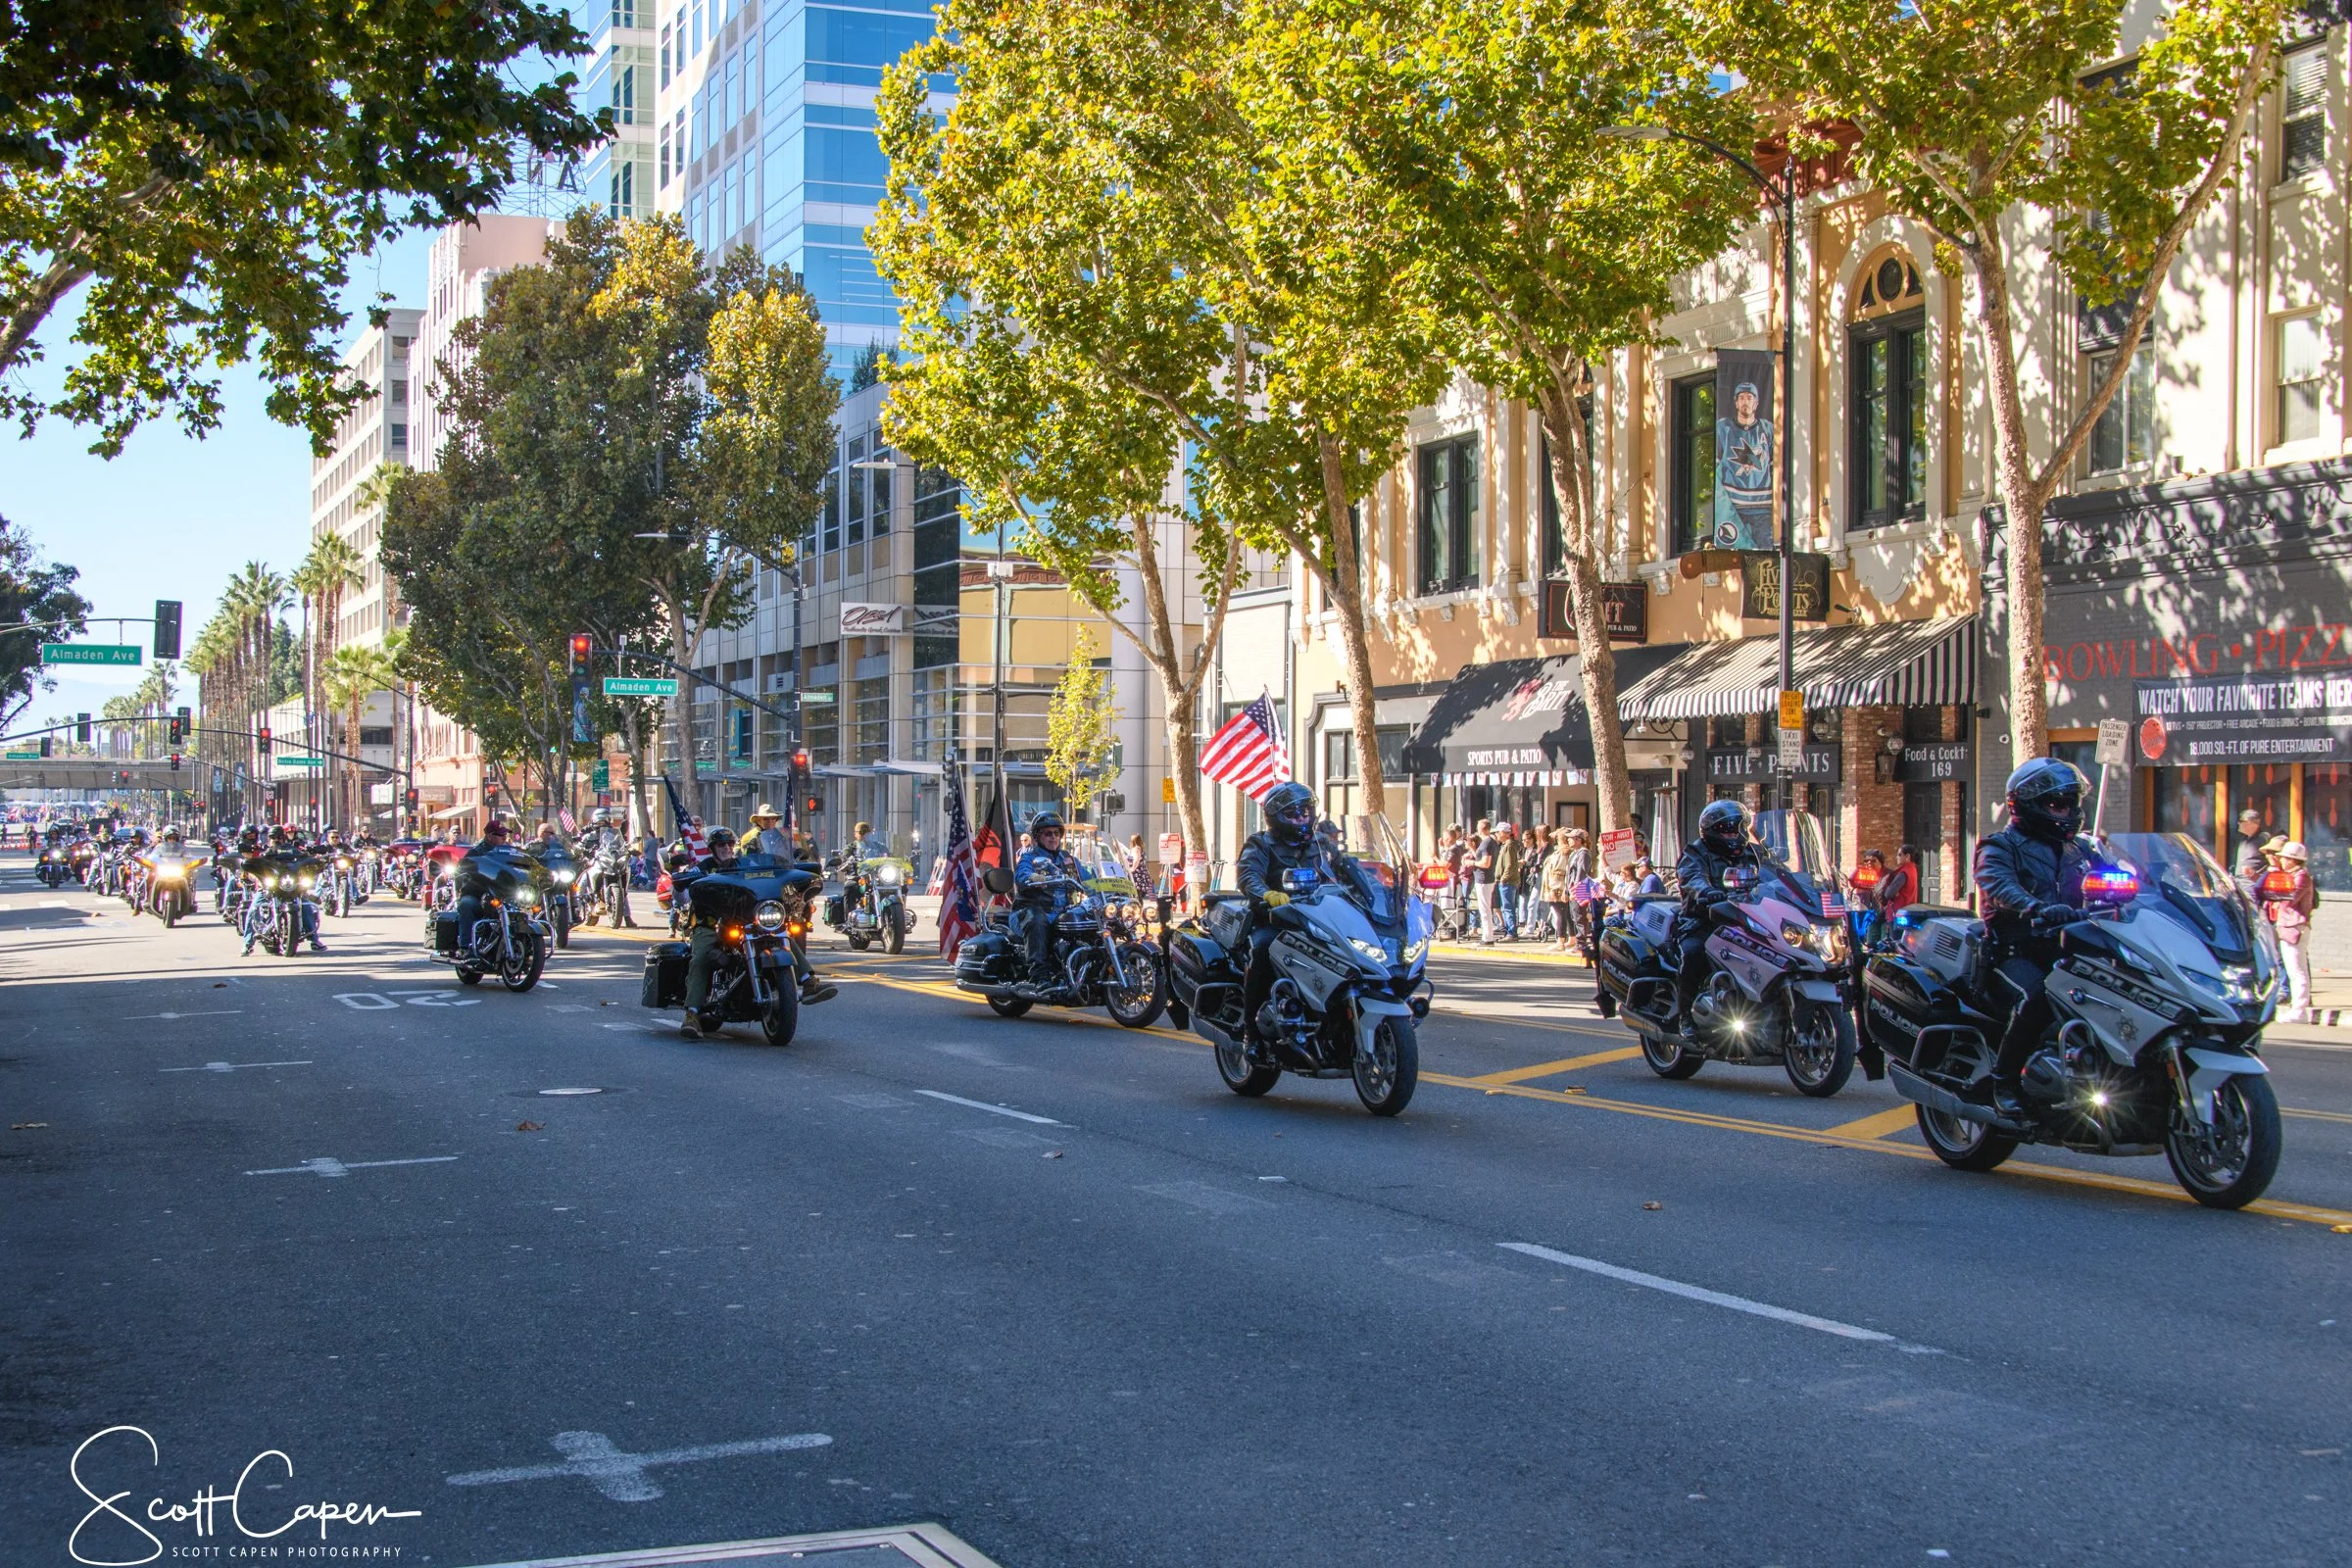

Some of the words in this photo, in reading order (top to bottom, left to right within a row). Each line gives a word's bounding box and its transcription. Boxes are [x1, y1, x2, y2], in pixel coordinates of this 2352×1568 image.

[1757, 558, 1781, 586] FIV
[1759, 585, 1811, 613] POTS
[51, 649, 104, 661] Almaden
[113, 651, 135, 661] Ave
[2042, 633, 2218, 682] BOWLING
[2255, 622, 2352, 669] PIZZ
[610, 682, 650, 691] Almaden
[656, 683, 673, 692] Ave
[1551, 680, 1570, 691] THE
[1519, 682, 1572, 720] BRIT
[2138, 688, 2180, 714] WATCH
[2182, 686, 2214, 713] YOUR
[2217, 683, 2276, 712] FAVORITE
[2278, 680, 2325, 709] TEAMS
[2101, 721, 2127, 731] PASSENGER
[2196, 719, 2224, 730] PROJECTOR
[2227, 718, 2238, 729] FREE
[2239, 718, 2259, 728] ARCADE
[2101, 730, 2125, 739] LOADING
[1904, 747, 1927, 761] Food
[1930, 750, 1936, 760] &
[2188, 740, 2214, 756] 18,000
[2239, 740, 2250, 755] OF
[2250, 739, 2271, 755] PURE
[2271, 737, 2334, 754] ENTERTAINMENT
[1467, 750, 1494, 765] SPORTS
[1494, 750, 1509, 765] PUB
[1511, 749, 1519, 764] &
[1520, 749, 1543, 764] PATIO
[1713, 755, 1752, 775] FIVE
[1767, 753, 1830, 773] PNTS
[1931, 760, 1952, 777] 169
[1617, 831, 1631, 840] AWAY
[1603, 842, 1615, 851] NO
[1109, 865, 1116, 875] 1
[1283, 935, 1350, 974] POLICE
[1720, 930, 1788, 967] POLICE
[2070, 958, 2184, 1017] POLICE
[1869, 996, 1922, 1038] POLICE
